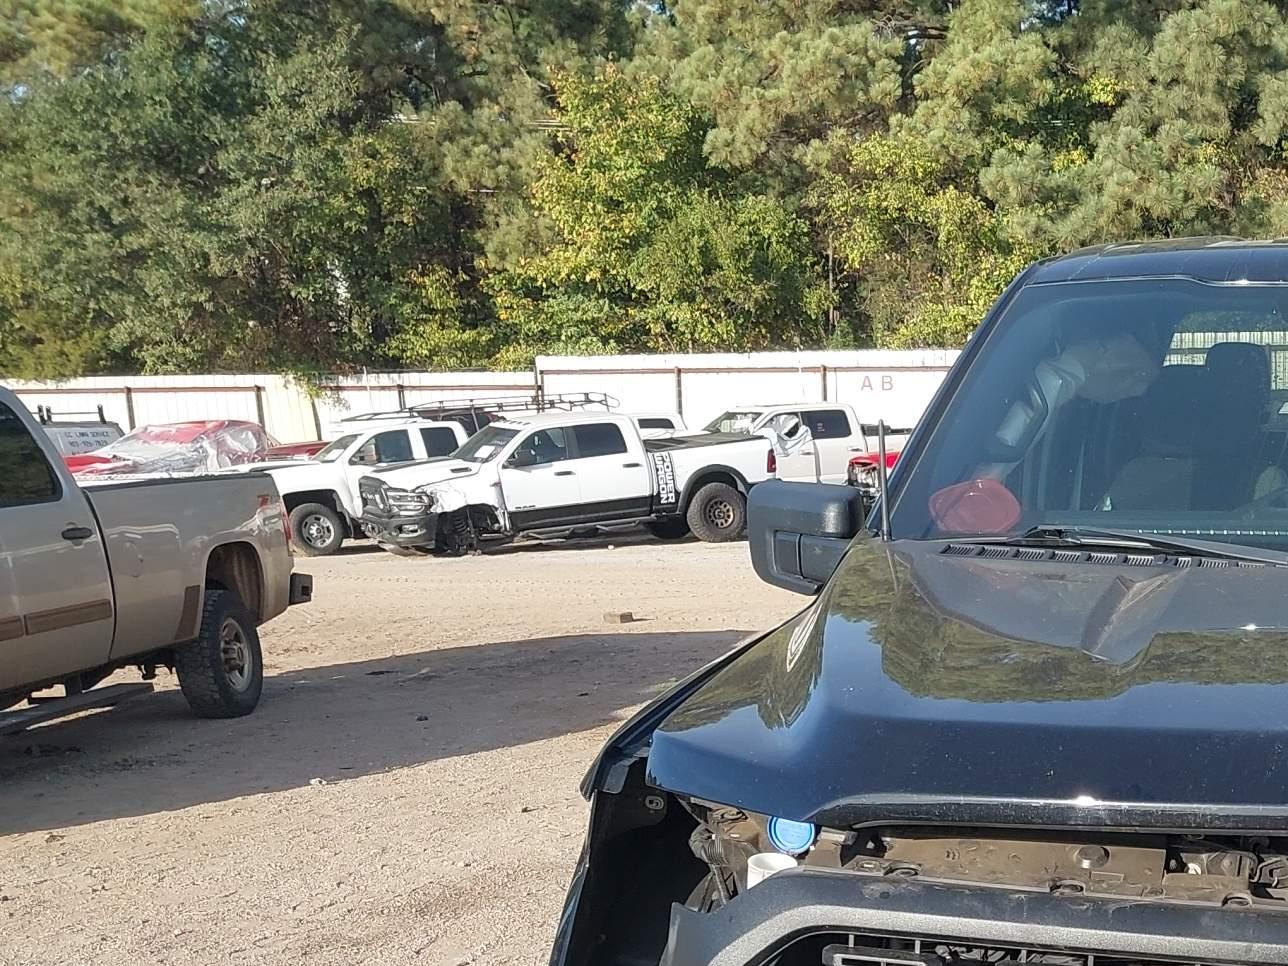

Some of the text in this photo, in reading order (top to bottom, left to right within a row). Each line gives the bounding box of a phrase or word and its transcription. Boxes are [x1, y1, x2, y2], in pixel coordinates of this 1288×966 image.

[860, 375, 894, 391] A B
[654, 453, 669, 504] WAGON
[662, 451, 676, 503] POWER
